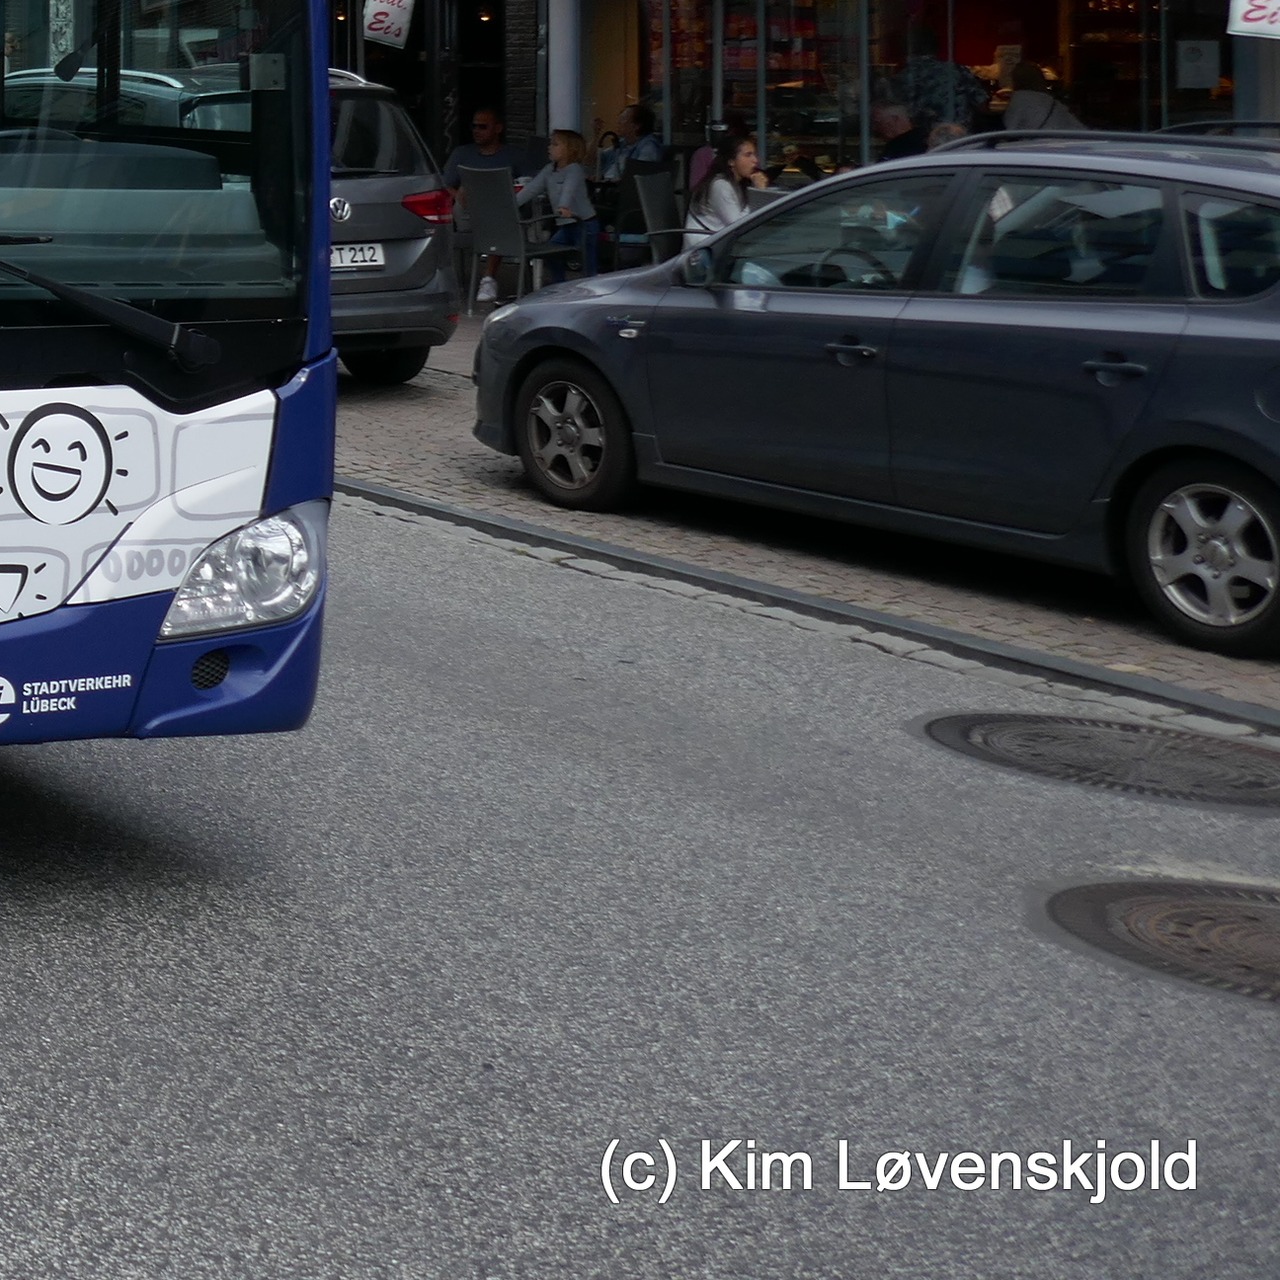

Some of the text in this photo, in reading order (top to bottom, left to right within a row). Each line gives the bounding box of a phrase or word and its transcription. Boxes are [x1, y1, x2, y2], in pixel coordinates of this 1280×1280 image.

[367, 11, 402, 38] Eis
[348, 246, 378, 263] 212
[22, 674, 132, 696] STADTVERKEHR
[22, 696, 77, 714] LÜBECK
